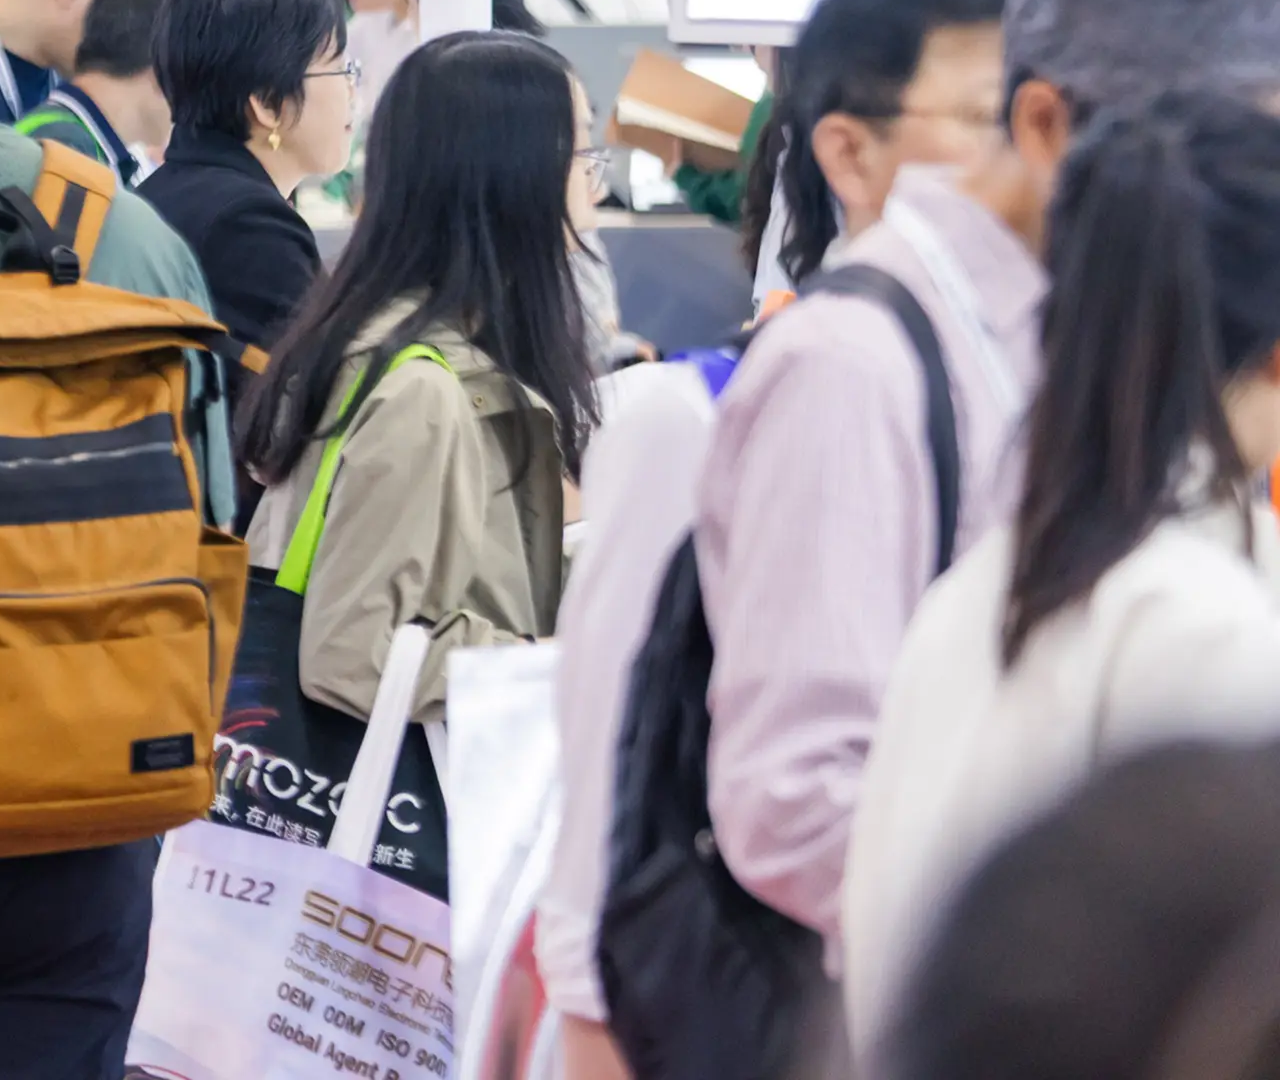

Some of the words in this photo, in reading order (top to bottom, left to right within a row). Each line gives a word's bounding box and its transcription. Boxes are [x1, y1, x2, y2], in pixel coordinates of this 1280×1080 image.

[212, 732, 426, 834] mozc
[267, 1012, 323, 1054] Global
[323, 1041, 380, 1080] Agent
[277, 981, 315, 1013] OEM
[323, 1004, 366, 1038] ODM
[375, 1028, 411, 1058] ISO
